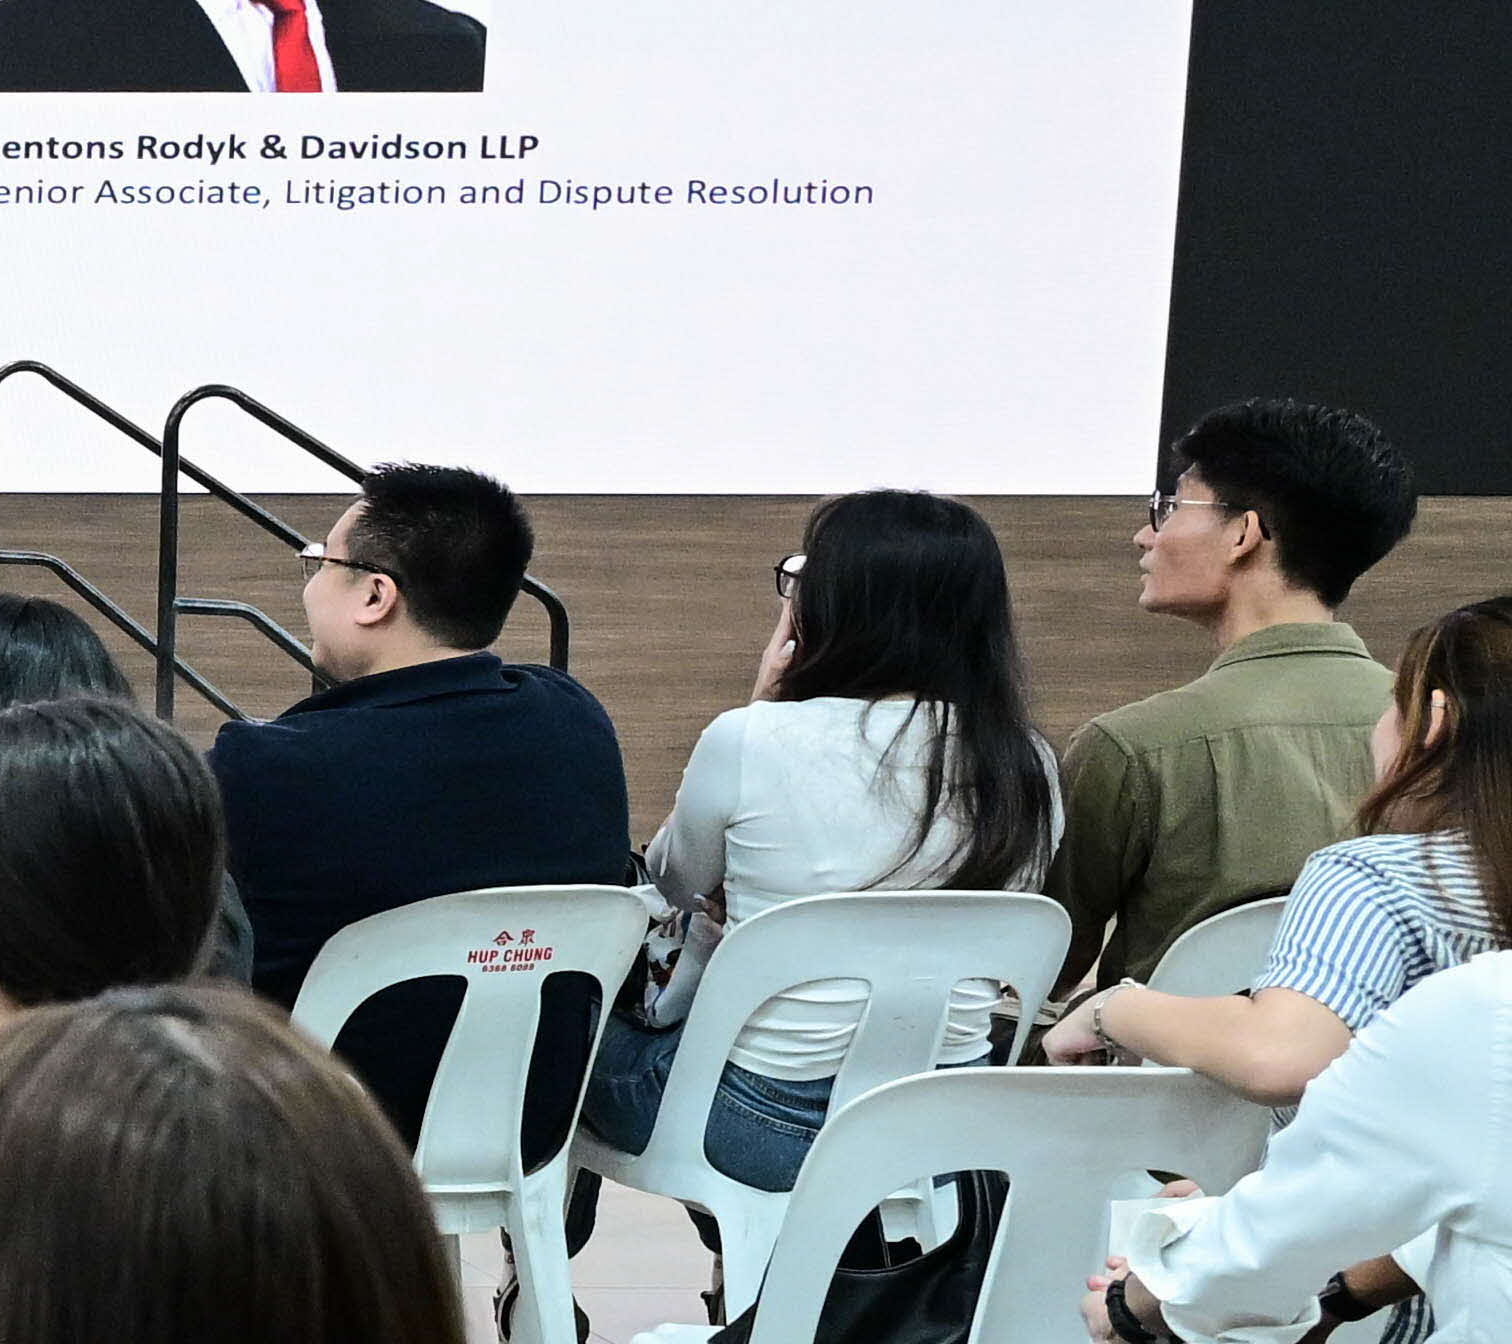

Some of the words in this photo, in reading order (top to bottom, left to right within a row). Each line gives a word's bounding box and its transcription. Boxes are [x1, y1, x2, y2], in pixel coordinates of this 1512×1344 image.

[137, 133, 247, 166] Rodyk
[259, 134, 288, 160] &
[301, 133, 467, 160] Davidson
[480, 135, 539, 160] LLP
[94, 179, 270, 209] Associate,
[286, 179, 446, 211] Litigation
[459, 178, 524, 204] and
[539, 179, 673, 211] Dispute
[687, 178, 873, 205] Resolution
[467, 950, 499, 963] HUP
[503, 947, 553, 962] CHUNG
